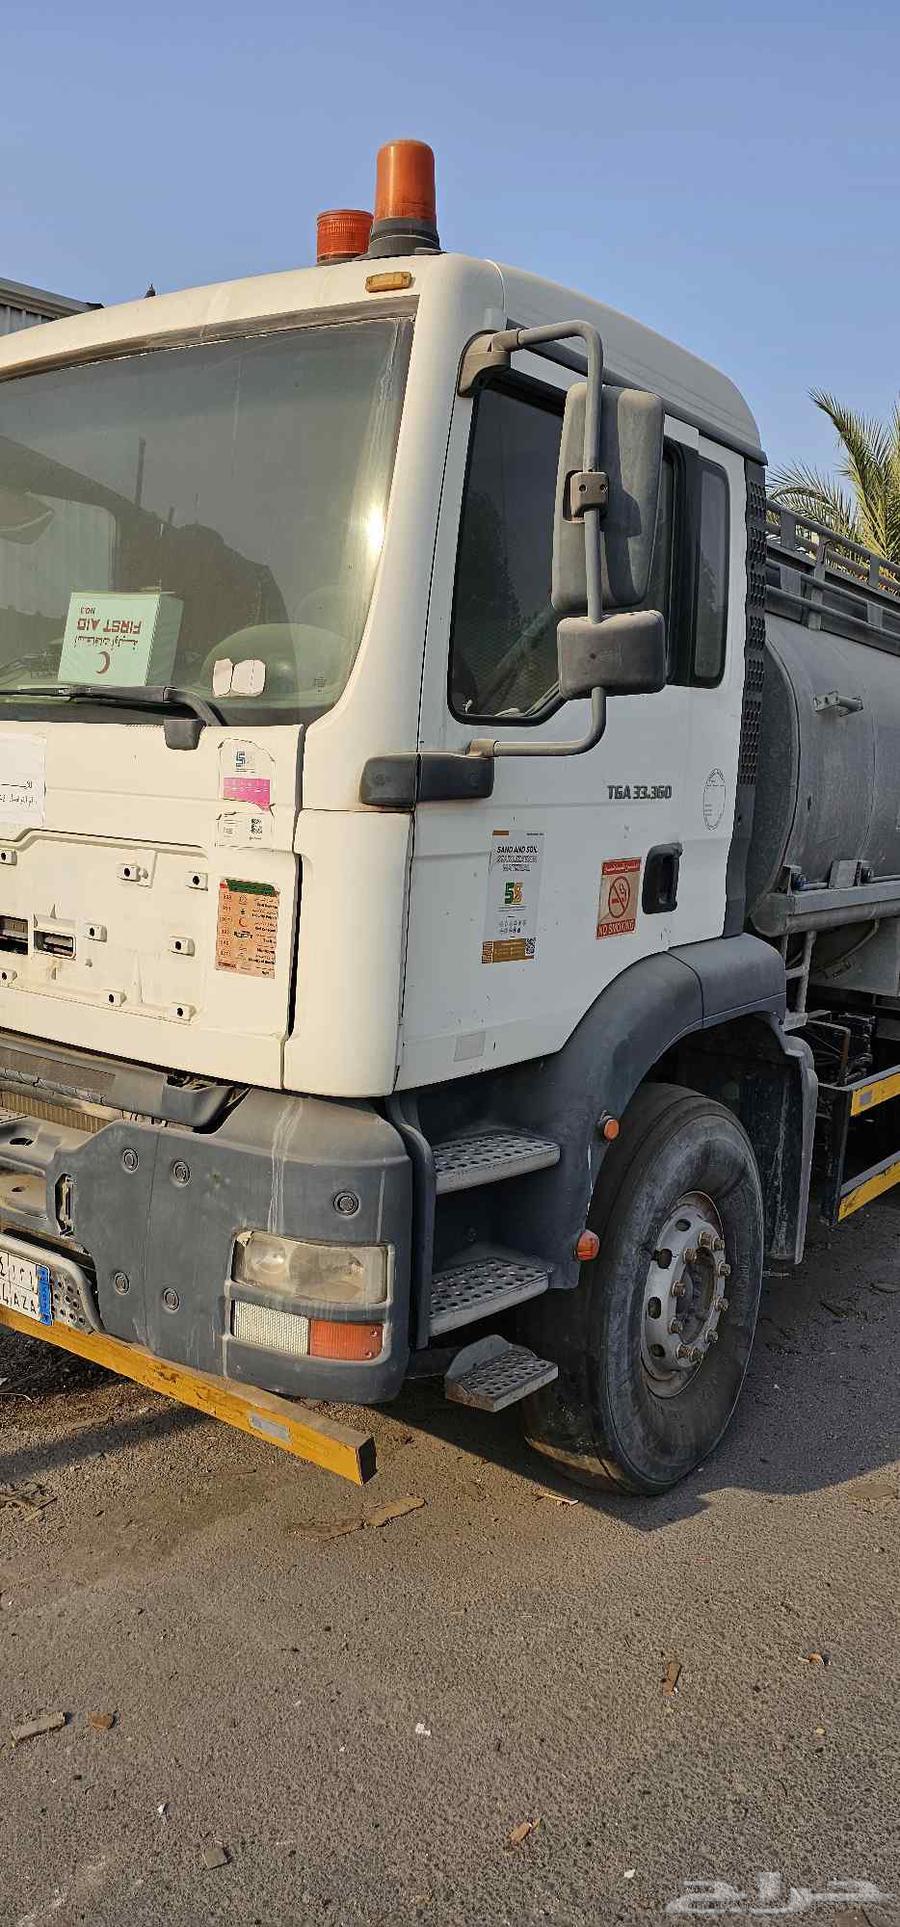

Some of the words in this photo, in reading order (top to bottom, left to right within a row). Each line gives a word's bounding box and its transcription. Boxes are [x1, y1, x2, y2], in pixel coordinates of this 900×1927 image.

[76, 617, 101, 631] AID
[103, 619, 142, 634] FIRST
[607, 786, 631, 800] TGA
[633, 786, 673, 800] 33.360
[598, 924, 608, 937] NO
[608, 919, 635, 934] SMOKING
